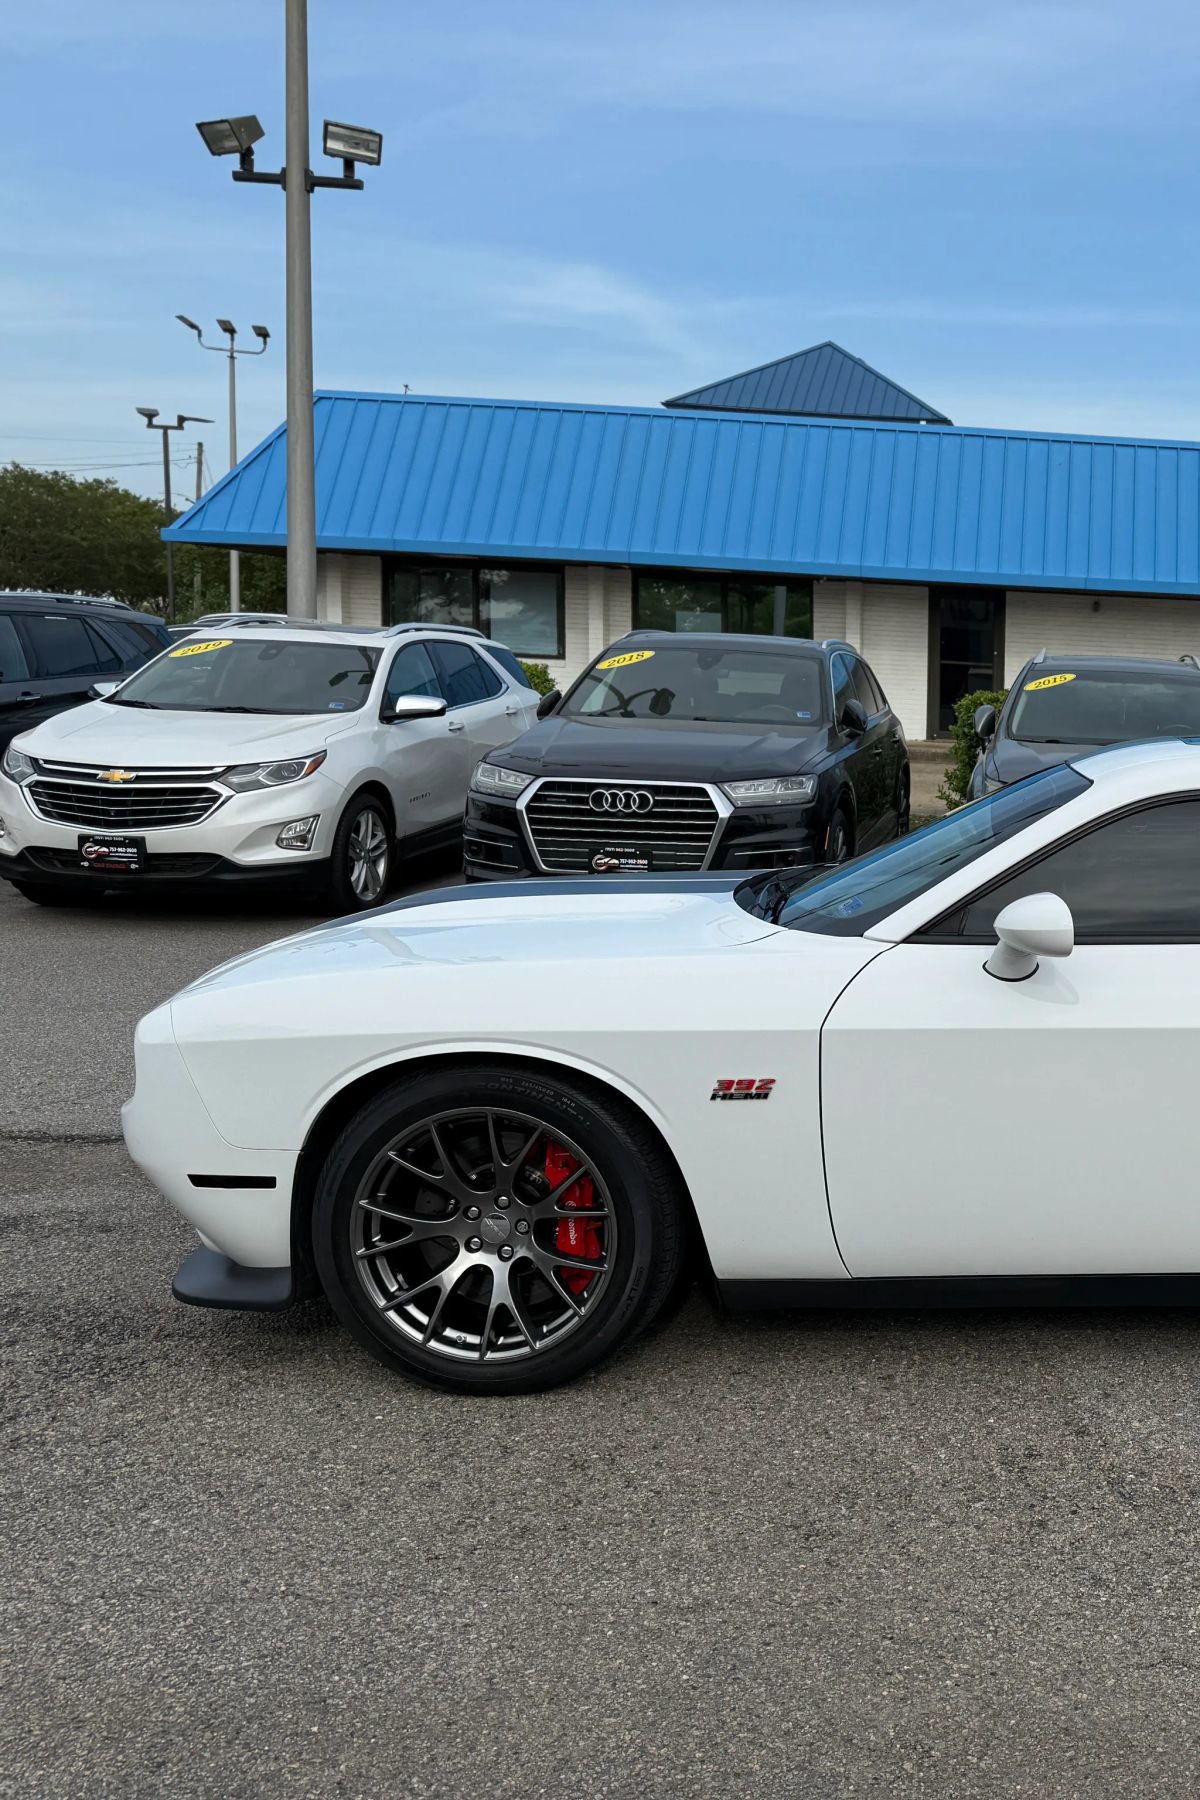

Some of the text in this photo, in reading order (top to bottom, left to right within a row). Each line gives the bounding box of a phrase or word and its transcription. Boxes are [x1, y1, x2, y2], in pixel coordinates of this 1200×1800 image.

[179, 641, 223, 656] 2019
[606, 652, 646, 668] 2018
[1033, 675, 1068, 689] 2015
[712, 1078, 777, 1093] 392
[709, 1092, 771, 1101] HEMI
